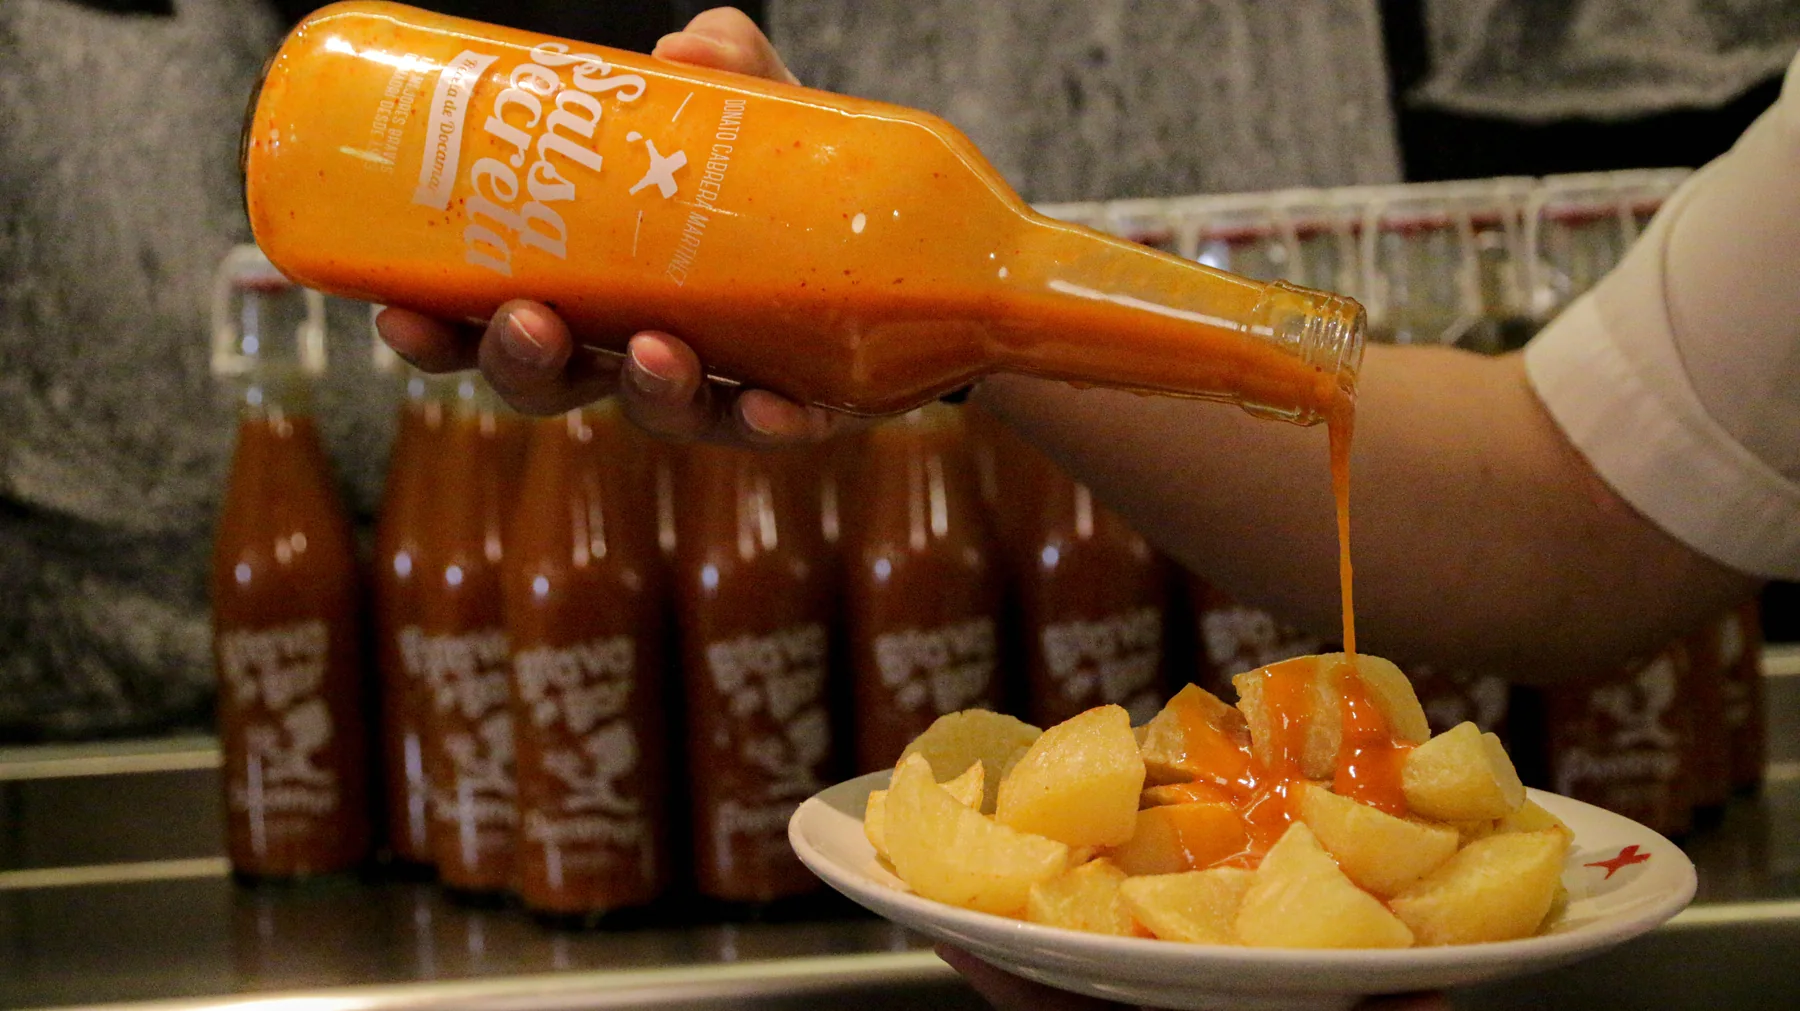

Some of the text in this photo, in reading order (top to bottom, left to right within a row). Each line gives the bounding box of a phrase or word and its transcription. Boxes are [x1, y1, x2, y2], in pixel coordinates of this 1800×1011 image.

[463, 42, 604, 277] Secreta
[518, 62, 646, 260] Salsa
[695, 144, 732, 208] CABRERA
[715, 100, 746, 140] DONATO
